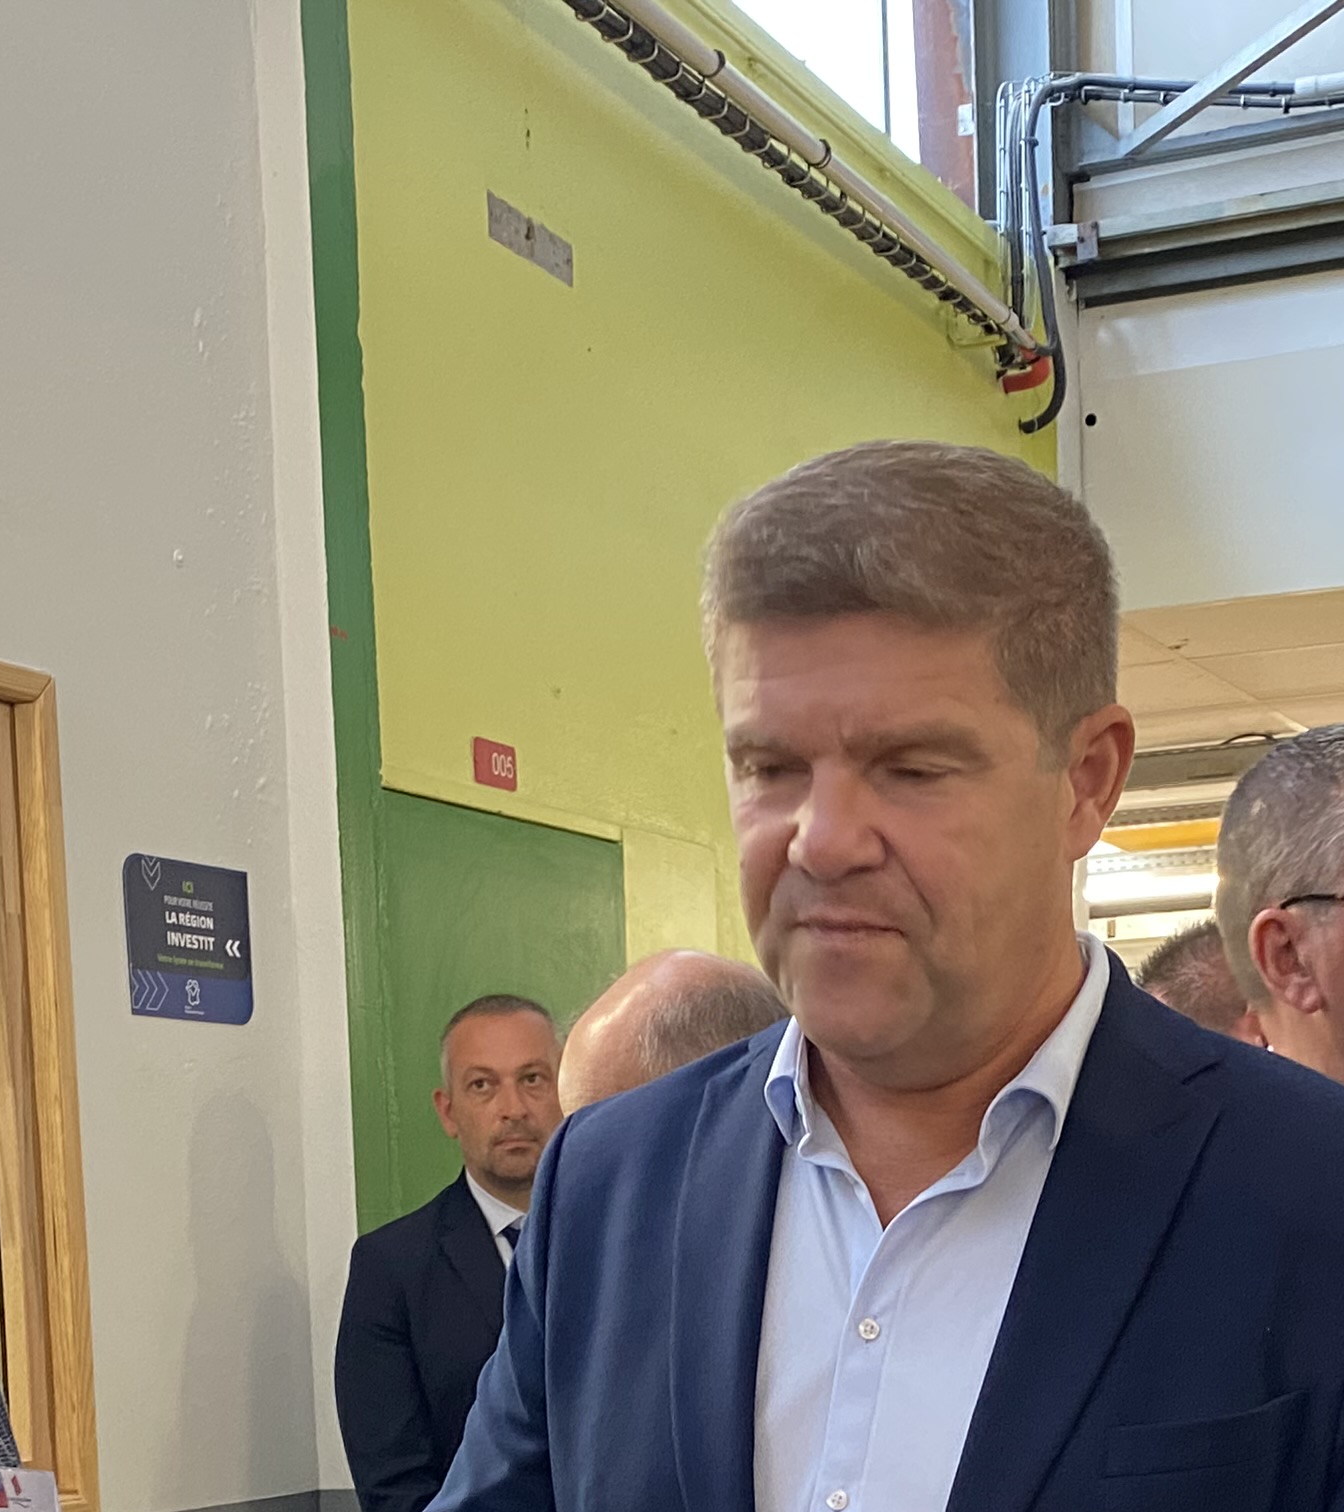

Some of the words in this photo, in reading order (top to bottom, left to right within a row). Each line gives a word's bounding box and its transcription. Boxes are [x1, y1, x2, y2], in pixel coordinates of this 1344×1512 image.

[492, 752, 514, 779] 005
[165, 911, 177, 925] LA
[178, 911, 214, 930] RÉGION
[167, 931, 215, 951] INVESTIT
